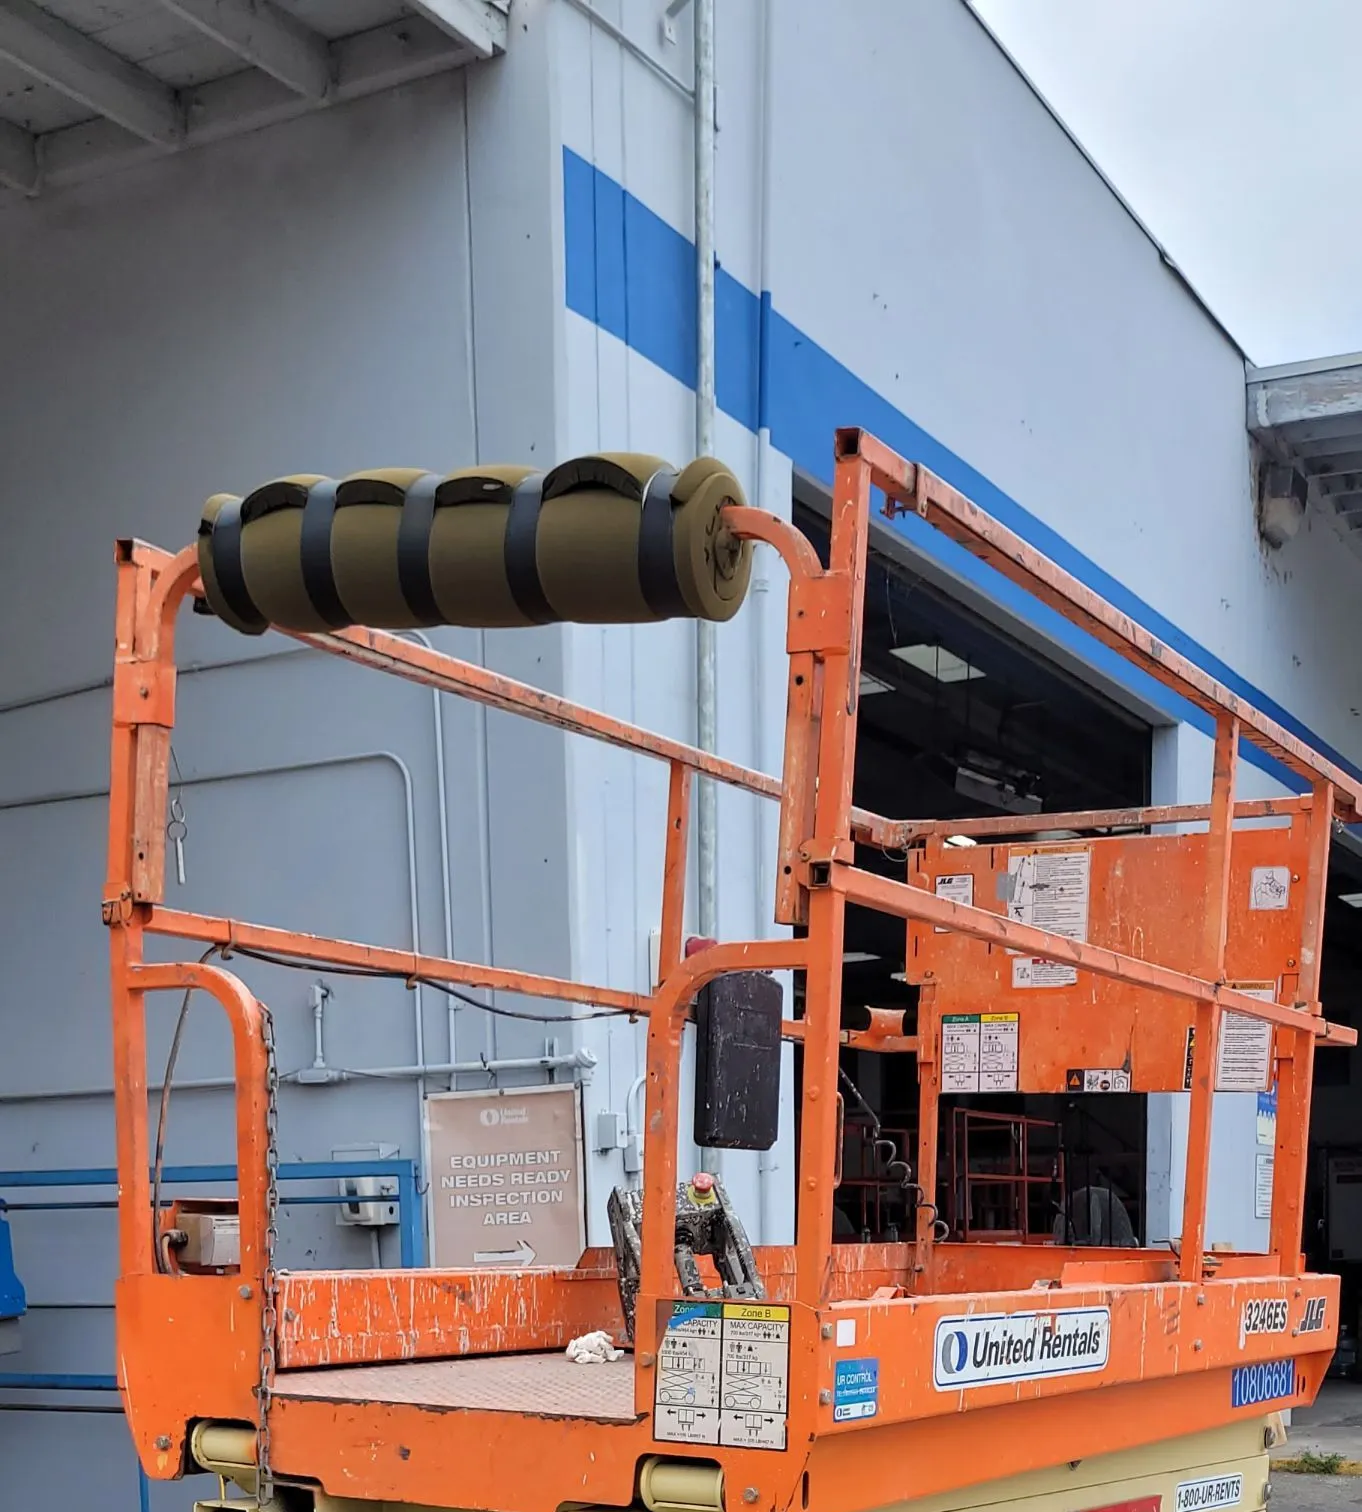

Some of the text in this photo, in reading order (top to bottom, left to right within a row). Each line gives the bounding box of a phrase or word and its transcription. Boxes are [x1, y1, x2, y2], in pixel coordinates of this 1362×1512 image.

[938, 877, 954, 885] JLG
[450, 1150, 561, 1170] EQUIPMENT
[441, 1170, 571, 1188] NEEDS READY
[450, 1190, 563, 1207] INSPECTION
[483, 1211, 532, 1225] AREA
[674, 1304, 695, 1314] Zon
[741, 1308, 771, 1318] Zone B
[1245, 1301, 1287, 1332] 3246ES
[1300, 1298, 1326, 1332] JLG
[730, 1321, 785, 1332] MAX CAPACITY
[972, 1322, 1100, 1369] United Rentals
[1234, 1360, 1293, 1406] 10806681
[1177, 1480, 1241, 1509] 1-800-UR-RENTS
